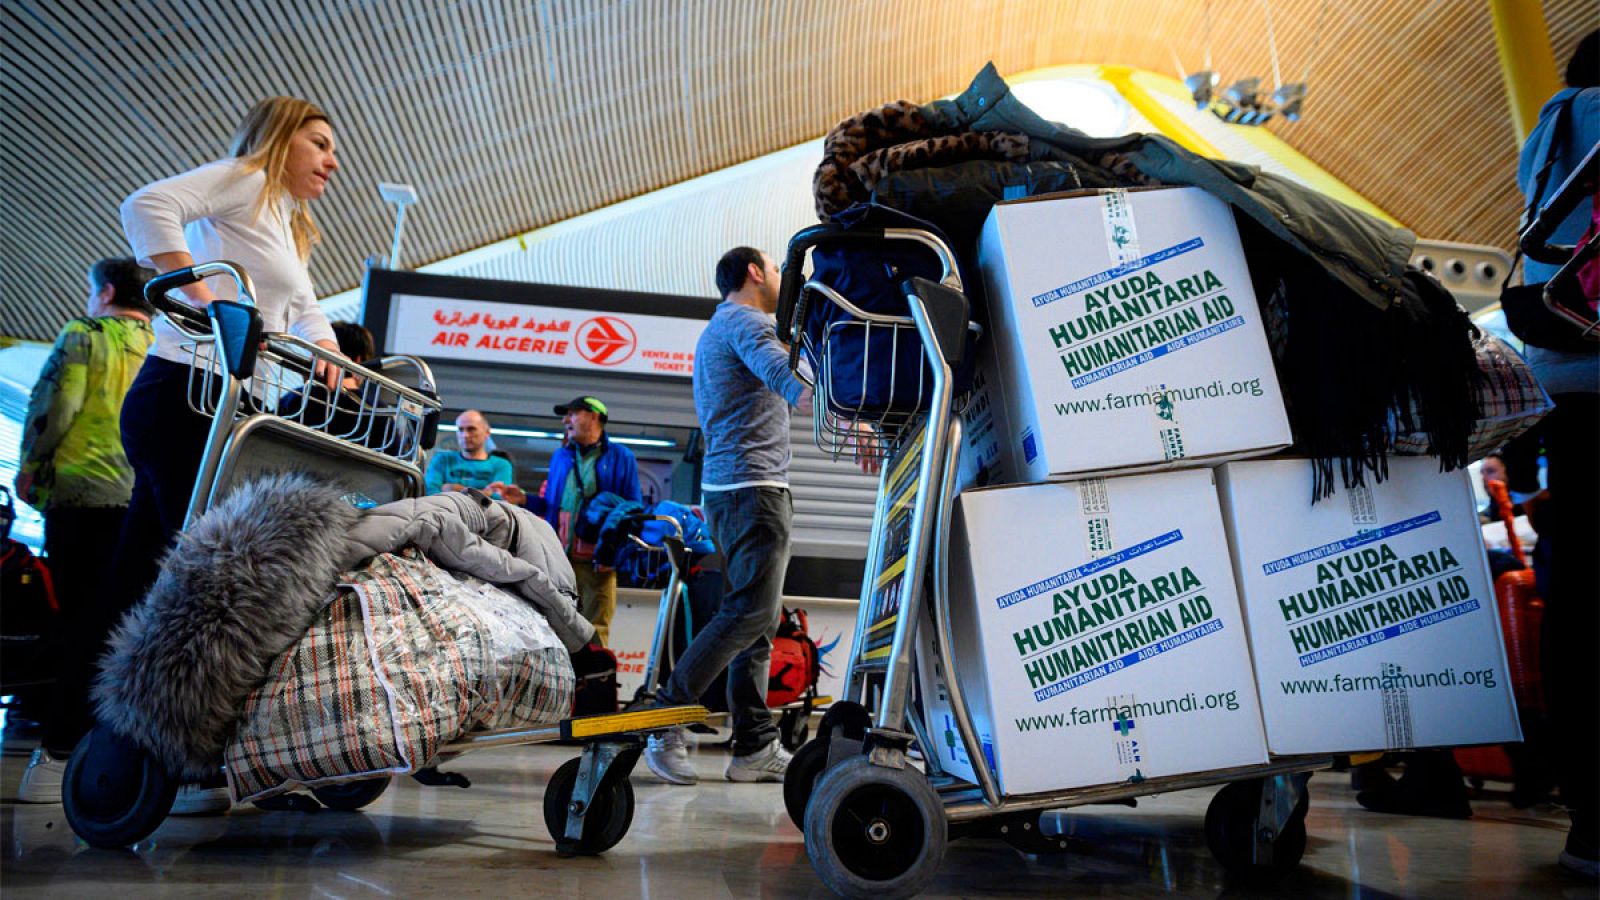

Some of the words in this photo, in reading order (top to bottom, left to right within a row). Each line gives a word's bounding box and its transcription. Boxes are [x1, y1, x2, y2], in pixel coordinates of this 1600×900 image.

[1060, 270, 1113, 297] HUMANITARIA
[1085, 271, 1163, 312] AYUDA
[1049, 270, 1223, 348] HUMANITARIA
[432, 331, 469, 347] AIR
[673, 352, 684, 360] DE
[1060, 307, 1202, 377] HUMANITARIAN
[1202, 295, 1234, 324] AID
[1072, 357, 1138, 389] HUMANITARIAN
[1138, 351, 1154, 365] AID
[1054, 376, 1263, 416] www.farmamundi.org
[1088, 519, 1097, 551] FARMA
[1095, 518, 1105, 550] MUNDI
[1291, 542, 1344, 567] HUMANITARIA
[1317, 544, 1398, 584] AYUDA
[998, 589, 1027, 608] AYUDA
[1027, 568, 1081, 597] HUMANITARIA
[1053, 568, 1137, 614] AYUDA
[1278, 546, 1460, 621] HUMANITARIA
[1013, 566, 1201, 655] HUMANITARIA
[1289, 586, 1437, 654] HUMANITARIAN
[1437, 575, 1471, 607] AID
[1024, 608, 1177, 689] HUMANITARIAN
[1179, 595, 1213, 629] AID
[1301, 636, 1369, 667] HUMANITARIAN
[1369, 630, 1385, 644] AID
[1399, 618, 1420, 635] AIDE
[1420, 599, 1480, 630] HUMANITAIRE
[616, 663, 645, 672] ERIE
[1036, 665, 1107, 701] HUMANITARIAN
[1107, 658, 1124, 674] AID
[1138, 643, 1160, 662] AIDE
[1160, 619, 1222, 652] HUMANITAIRE
[1280, 667, 1496, 695] www.farmamundi.org
[1015, 690, 1239, 732] www.farmamundi.org
